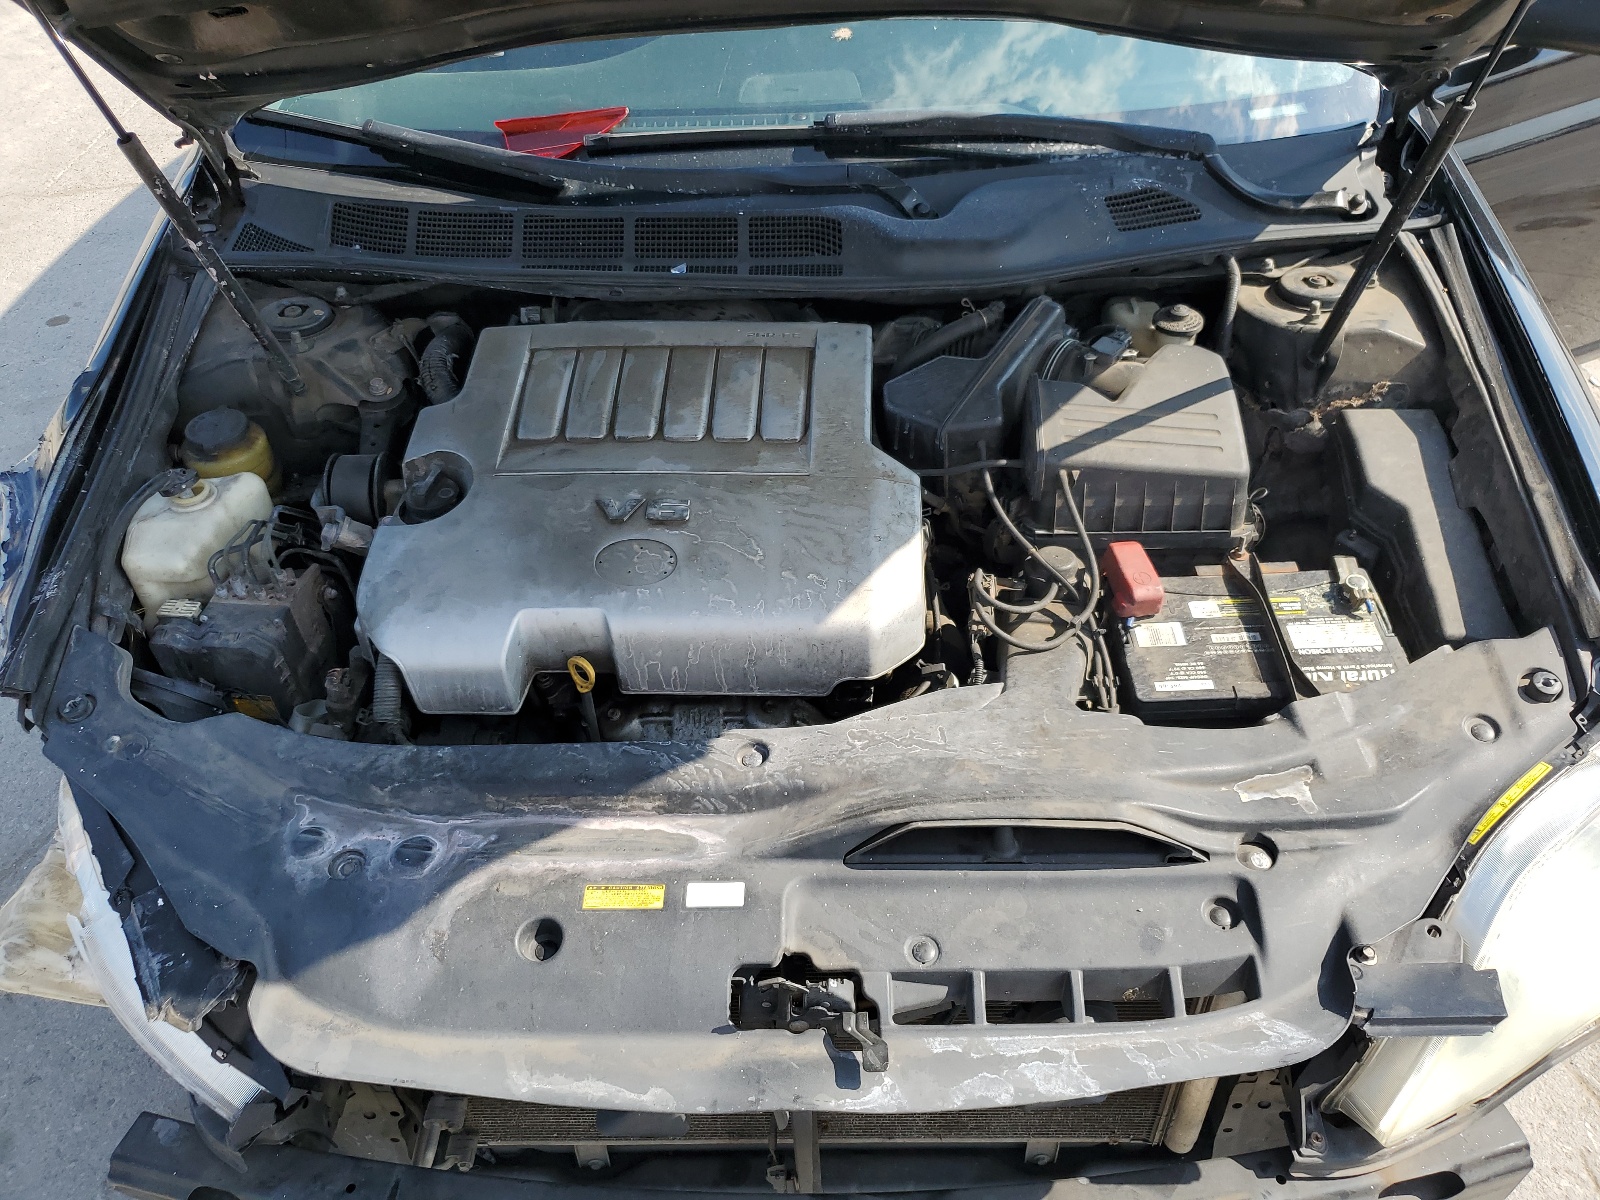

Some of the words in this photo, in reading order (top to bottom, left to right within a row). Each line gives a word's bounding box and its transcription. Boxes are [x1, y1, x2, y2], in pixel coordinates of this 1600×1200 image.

[595, 498, 691, 523] V6
[1298, 647, 1331, 655] POISON
[1337, 646, 1373, 654] DANGER
